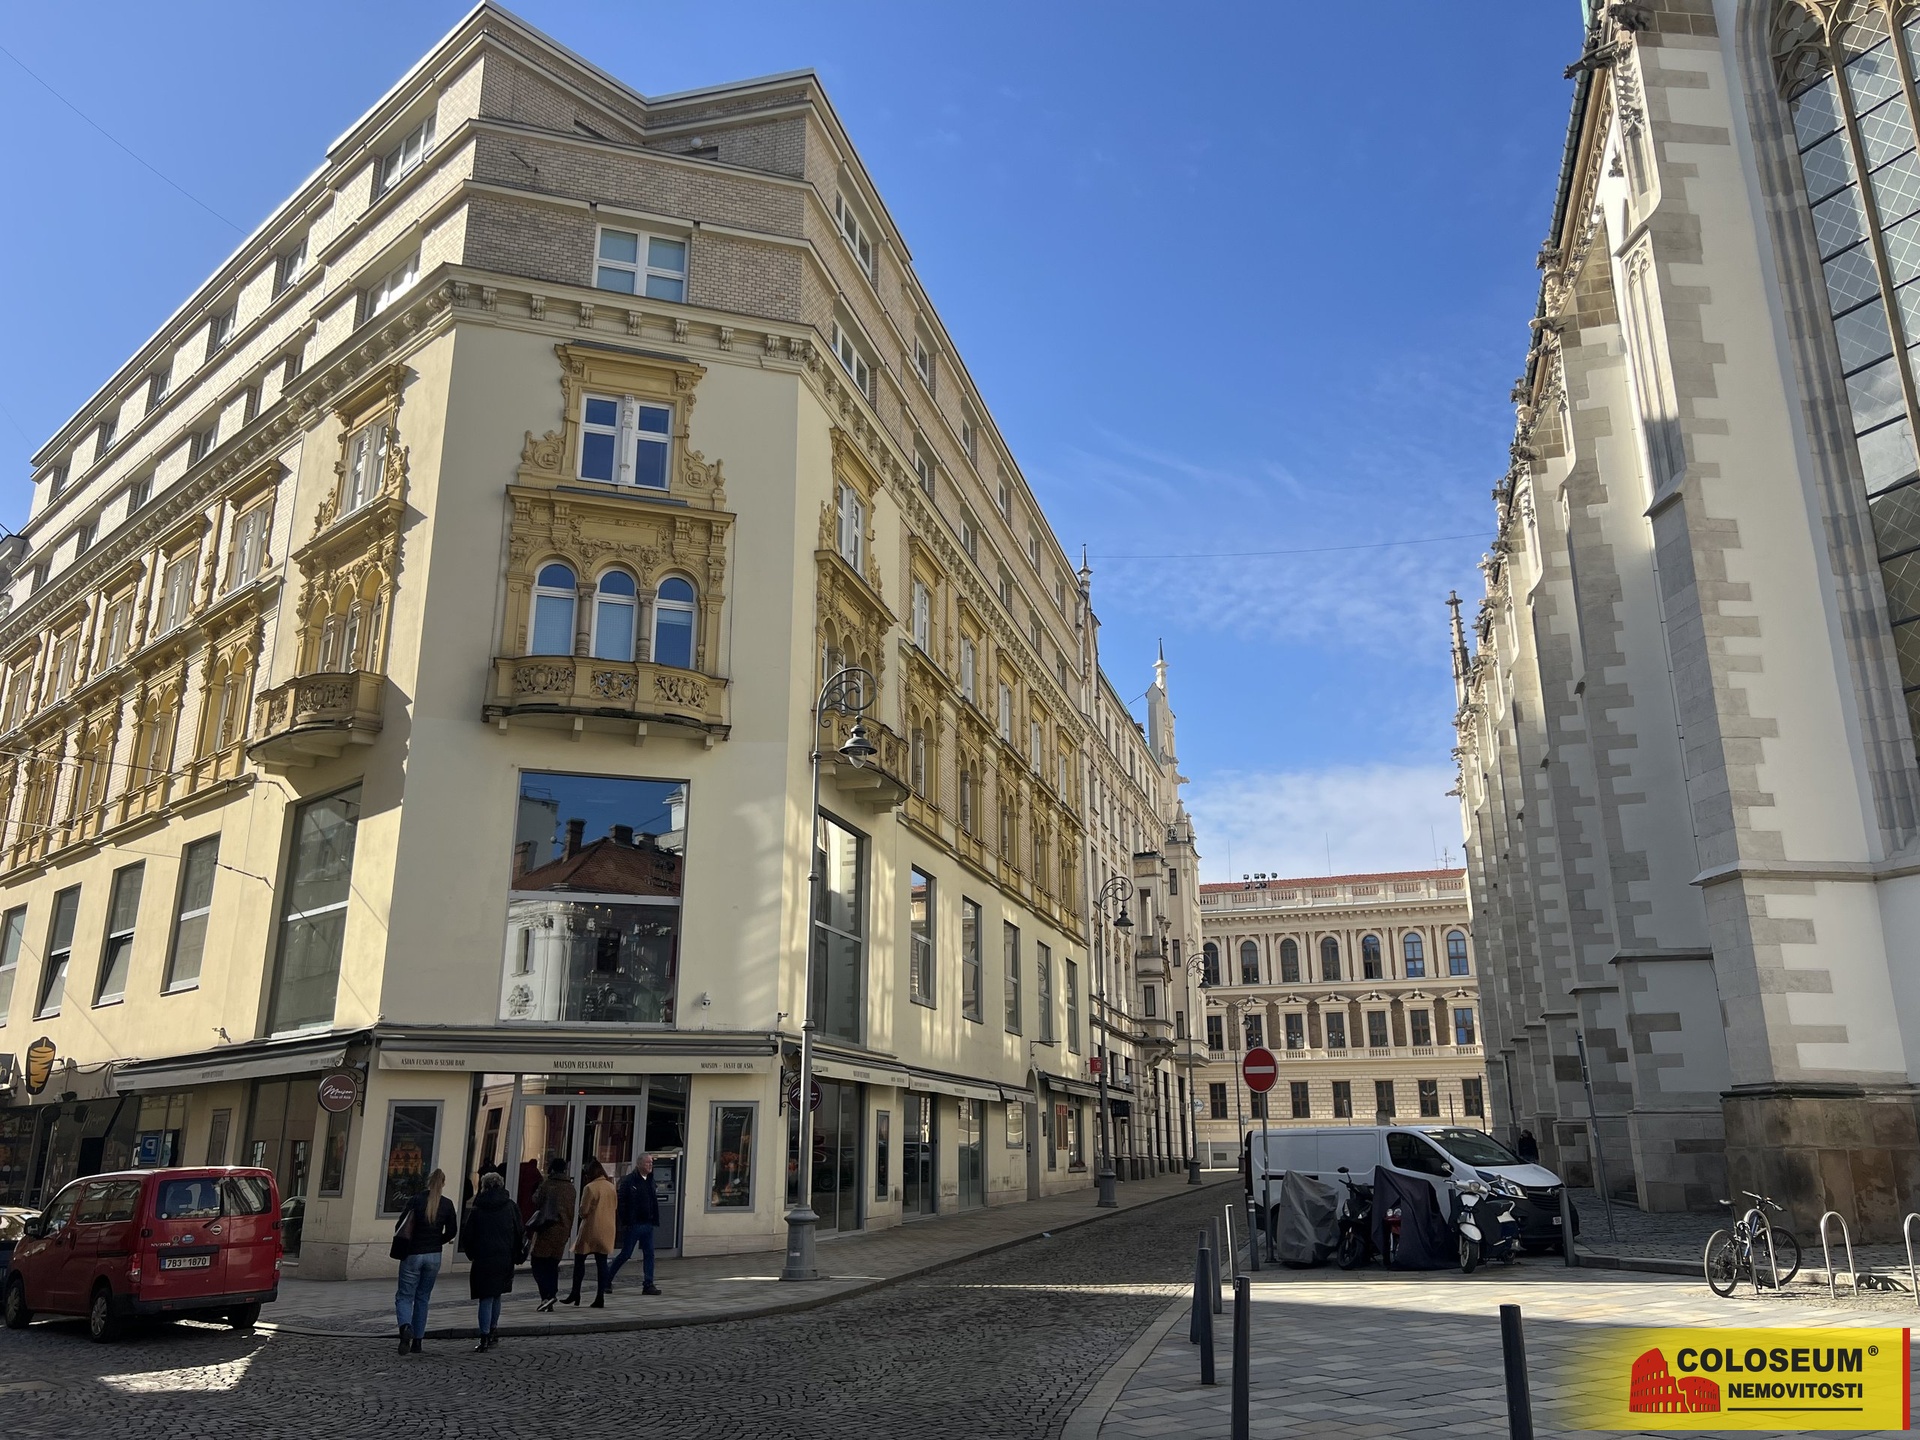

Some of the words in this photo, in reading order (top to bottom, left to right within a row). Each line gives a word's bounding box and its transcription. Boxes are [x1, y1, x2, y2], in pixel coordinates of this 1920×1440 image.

[553, 1060, 576, 1069] MAISON
[577, 1060, 614, 1069] RESTAURANT
[167, 1259, 182, 1268] 7B3
[188, 1257, 207, 1267] 1870
